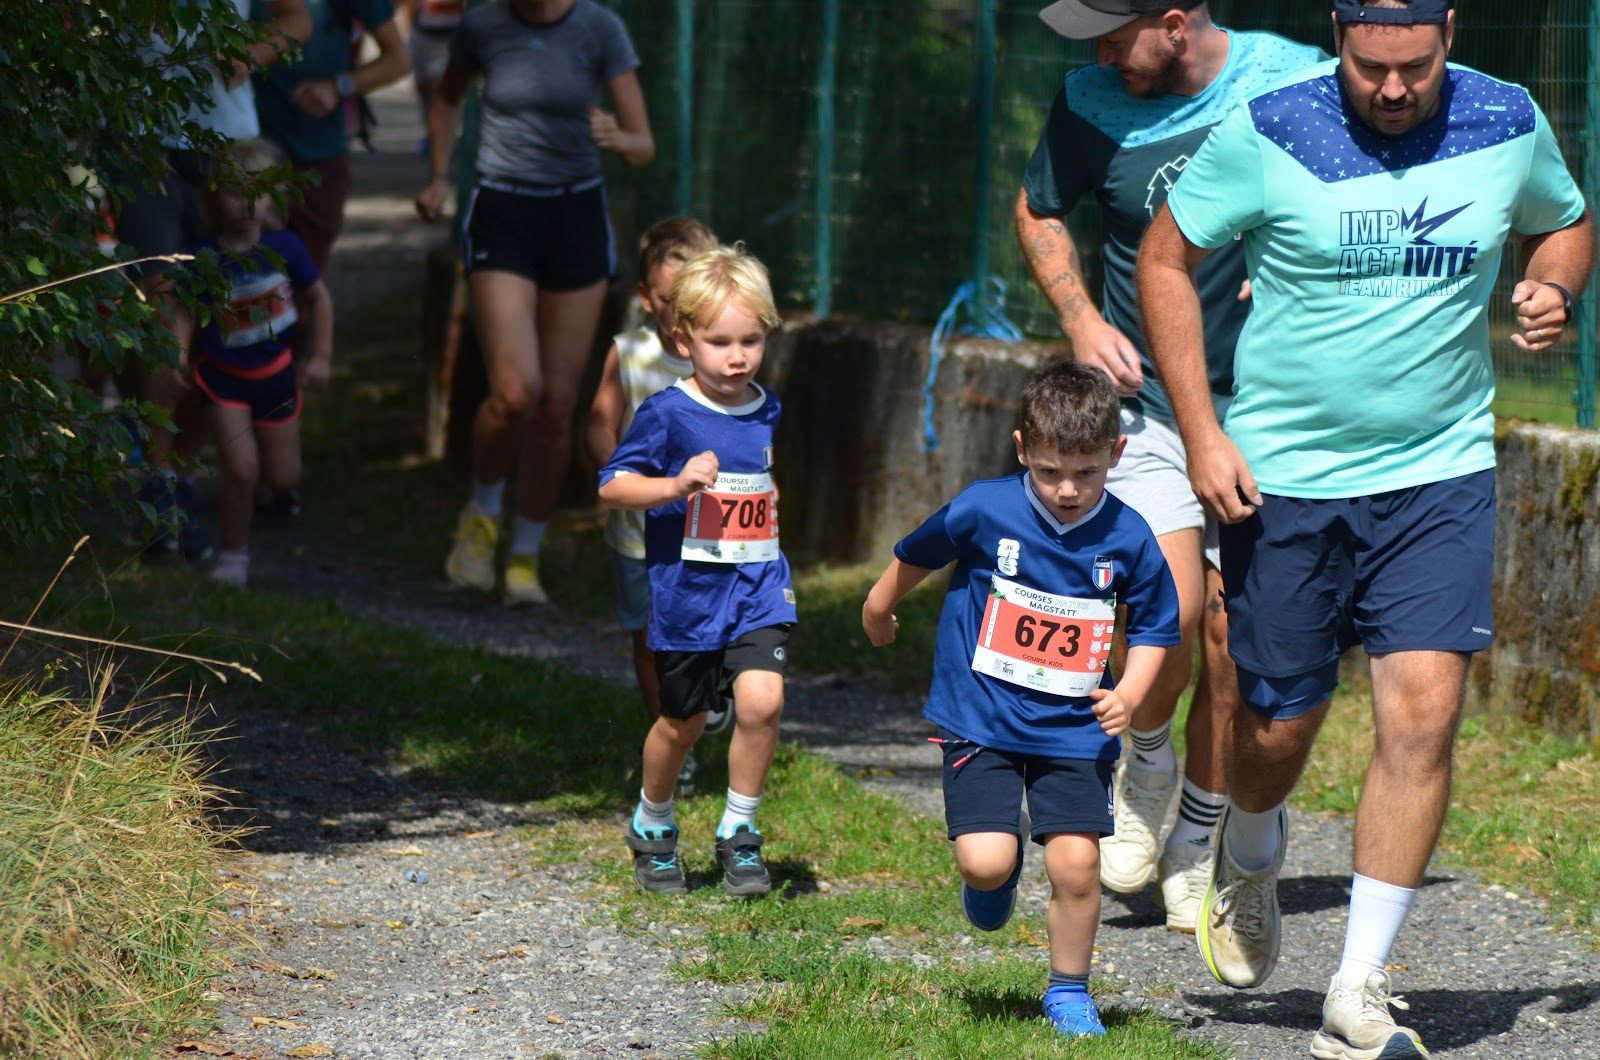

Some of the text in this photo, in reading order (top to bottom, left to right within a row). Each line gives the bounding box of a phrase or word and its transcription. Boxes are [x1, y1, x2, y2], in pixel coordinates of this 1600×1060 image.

[1339, 209, 1400, 246] IMP
[1338, 277, 1393, 297] TEAM
[720, 498, 768, 529] 708
[1014, 587, 1053, 604] COURSES
[1029, 601, 1077, 617] MAGSTATT
[1014, 614, 1081, 657] 673
[1022, 653, 1063, 668] COURSE KIDS
